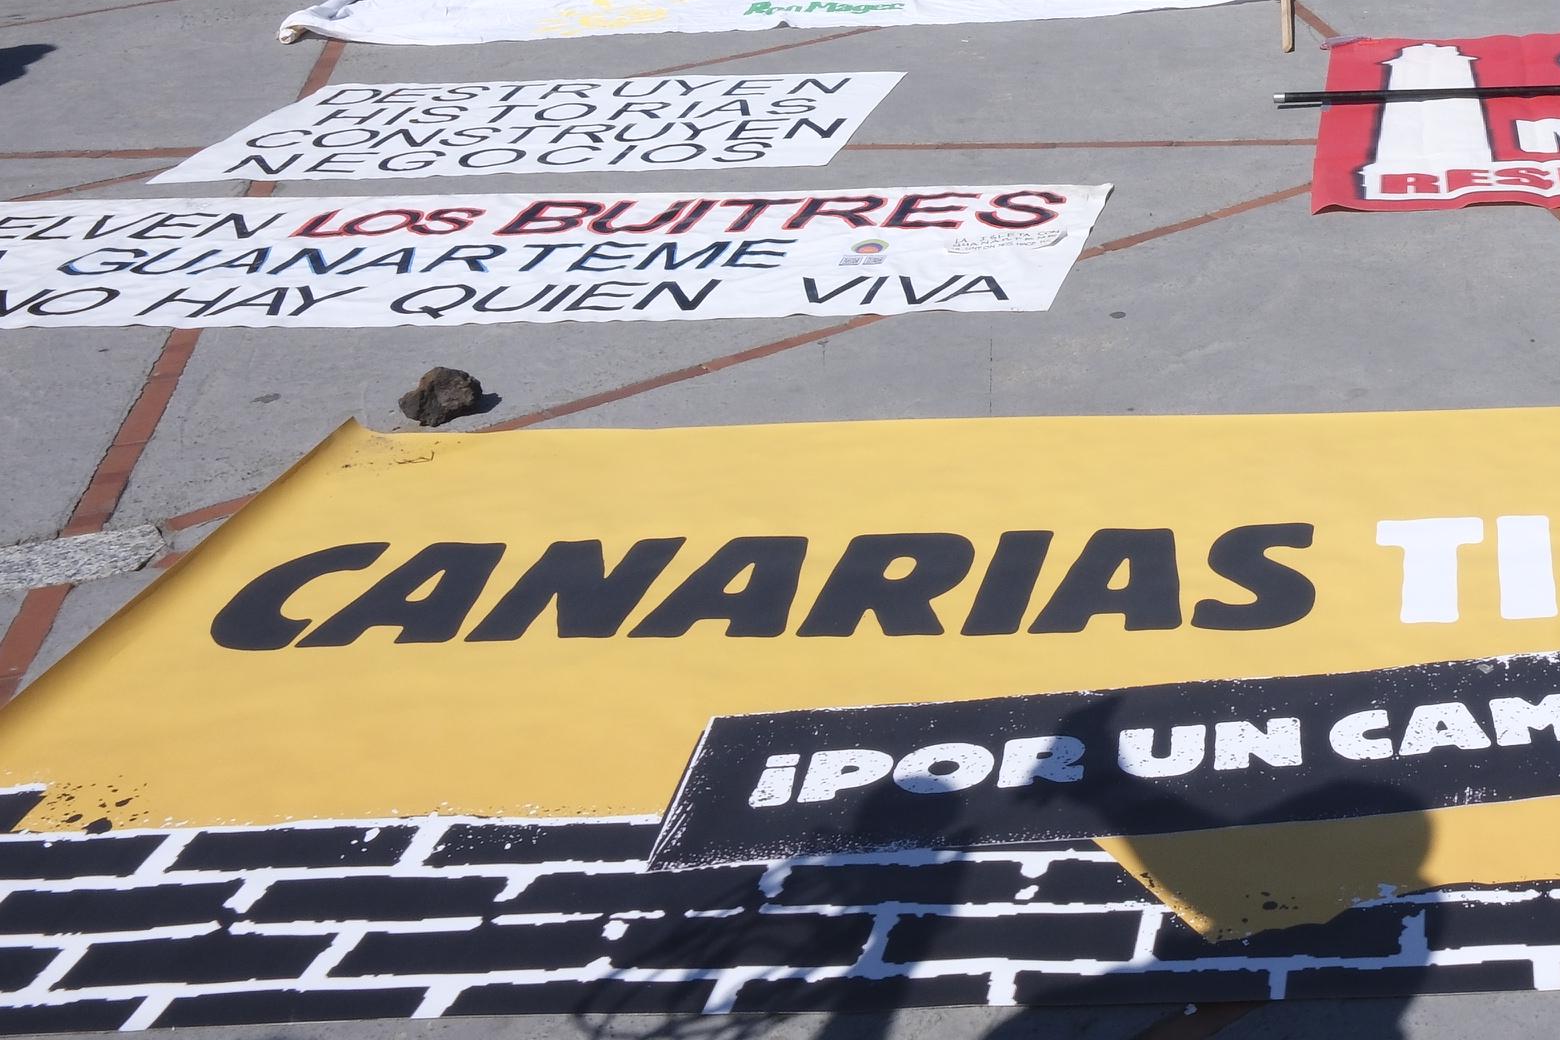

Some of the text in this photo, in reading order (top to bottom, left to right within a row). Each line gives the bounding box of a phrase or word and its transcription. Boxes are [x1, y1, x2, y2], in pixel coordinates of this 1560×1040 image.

[312, 97, 817, 126] HISTORIAS
[316, 77, 852, 106] DESTRUYEN
[245, 117, 848, 149] CONSTRUYEN
[224, 140, 774, 175] NEGOCIOS
[287, 206, 487, 239] LOS
[493, 189, 1068, 237] BUITRES
[56, 237, 799, 277] GUANARTEME
[134, 284, 368, 317] HAY
[389, 278, 723, 320] QUIEN
[801, 274, 1011, 307] VIVA
[209, 521, 1316, 652] CANARIAS
[748, 735, 1086, 809] ¡POR
[1116, 716, 1303, 780] UN
